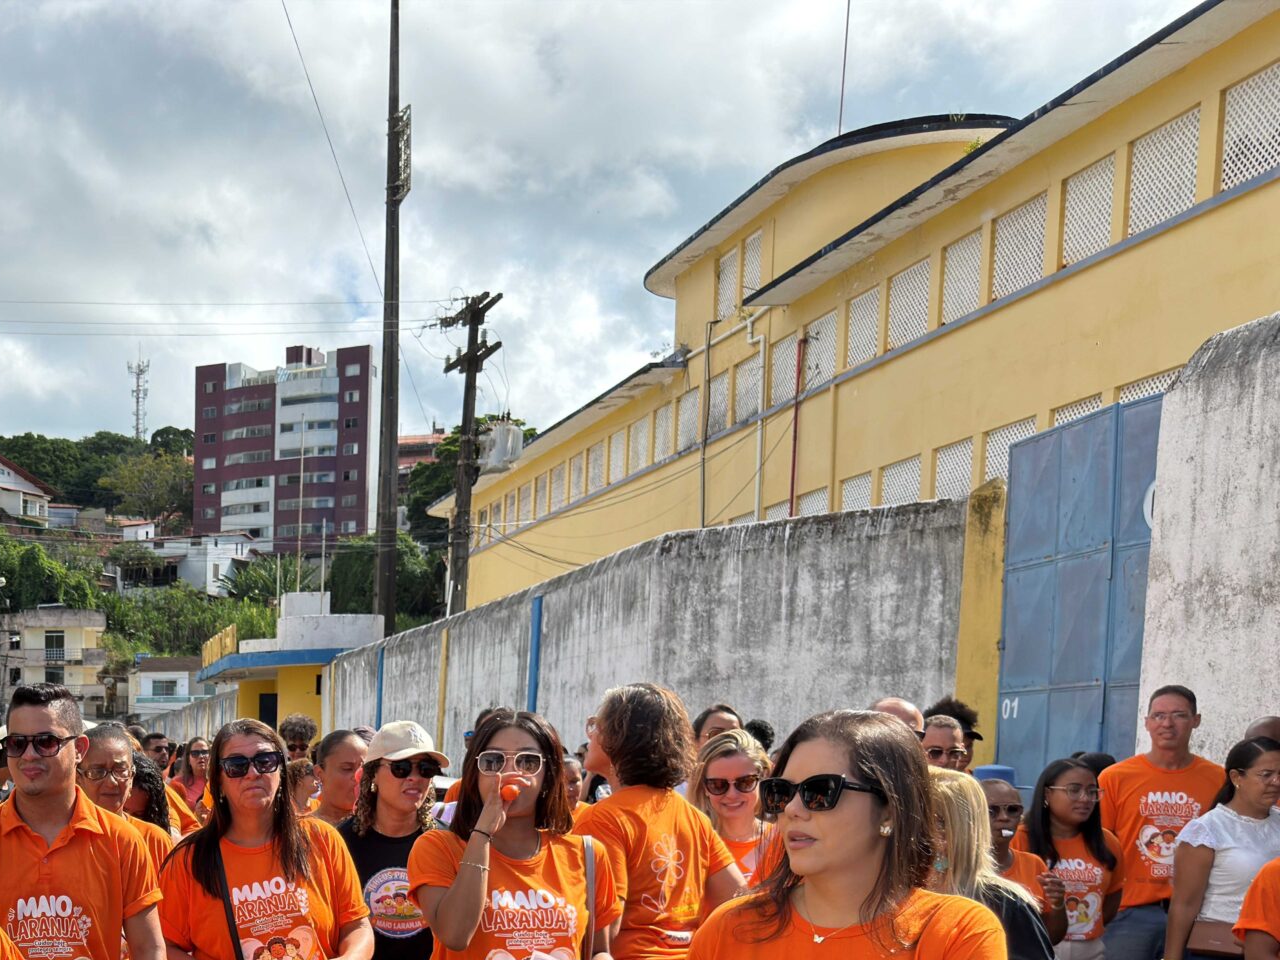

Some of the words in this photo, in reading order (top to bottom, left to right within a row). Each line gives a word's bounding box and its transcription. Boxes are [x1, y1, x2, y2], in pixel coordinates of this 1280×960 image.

[1002, 697, 1019, 719] 01
[1140, 803, 1193, 816] LARANJA
[1148, 792, 1187, 804] MAIO
[232, 876, 287, 906] MAIO
[492, 889, 555, 911] MAIO
[17, 895, 73, 920] MAIO
[235, 892, 299, 924] ARANJA
[7, 917, 82, 942] LARANJA
[481, 908, 568, 933] LARANJA
